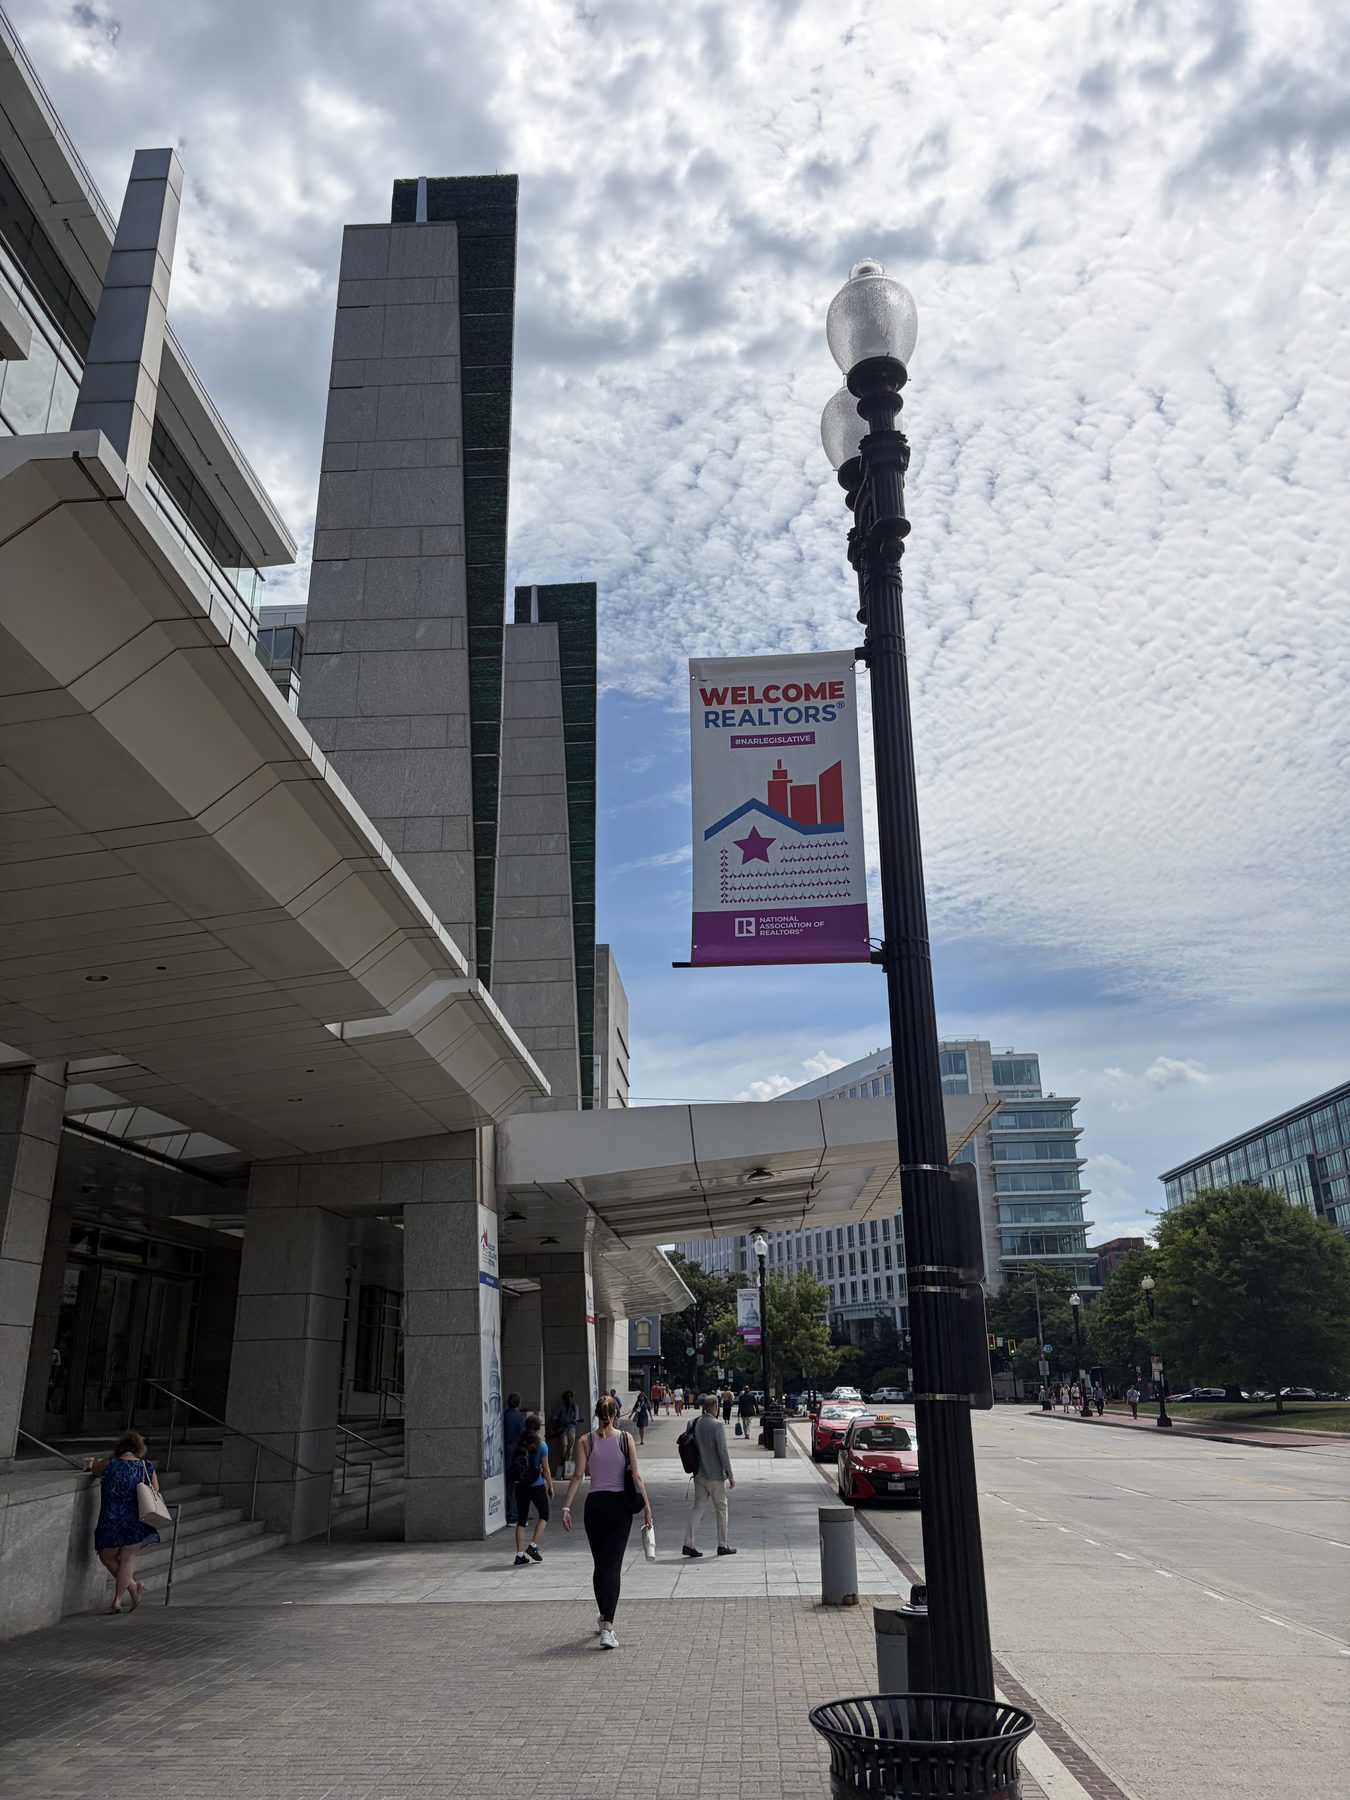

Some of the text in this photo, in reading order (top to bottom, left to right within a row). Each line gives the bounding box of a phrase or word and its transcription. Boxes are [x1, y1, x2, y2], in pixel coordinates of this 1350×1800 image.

[699, 681, 846, 707] WELCOME
[735, 734, 811, 746] #NARLEGISLATIVE
[759, 922, 812, 930] ASSOCIATION
